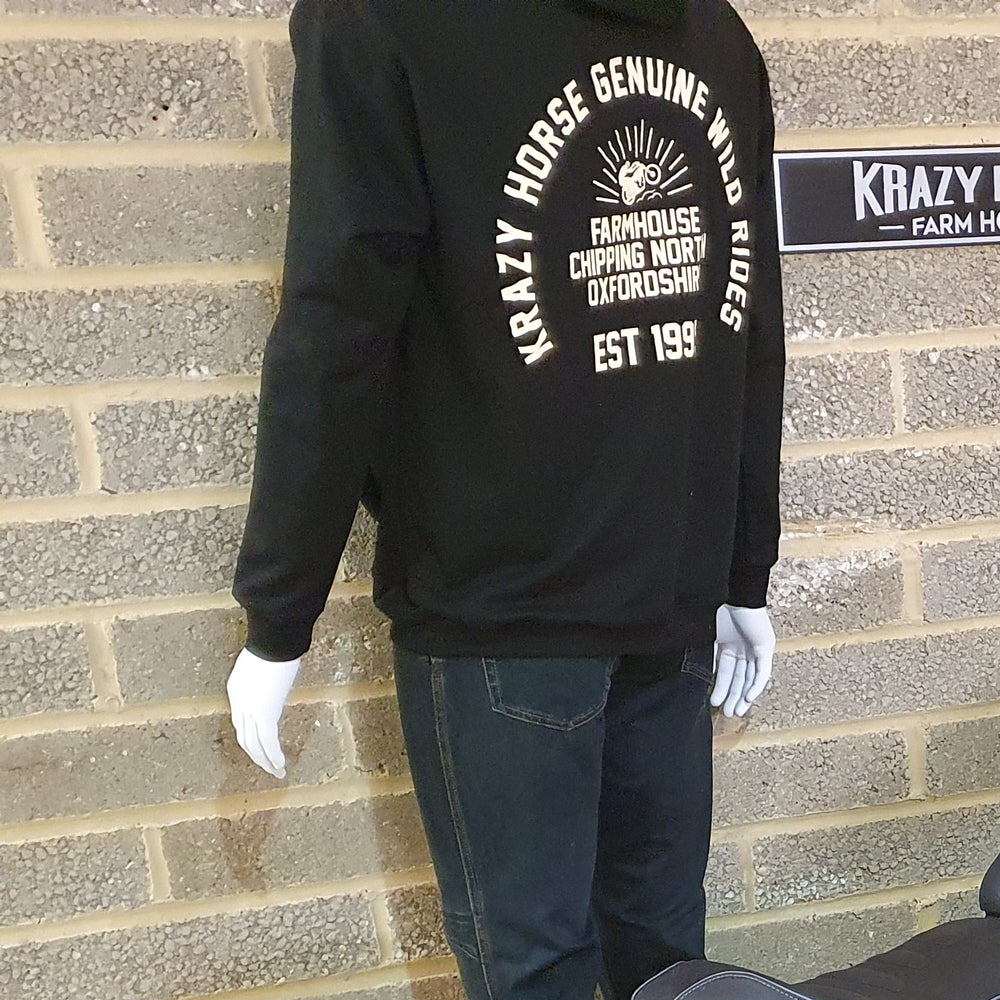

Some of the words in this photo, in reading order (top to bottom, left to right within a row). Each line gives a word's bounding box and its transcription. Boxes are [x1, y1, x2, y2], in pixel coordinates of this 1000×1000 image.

[590, 56, 709, 120] GENUINE
[503, 79, 590, 207] HORSE
[707, 106, 743, 206] WILD
[852, 160, 983, 221] KRAZY
[590, 206, 701, 246] FARMHOUSE
[912, 213, 972, 236] FARM
[569, 242, 645, 280] CHIPPING
[650, 233, 707, 267] NORT
[587, 266, 700, 307] OXFORDSHIR
[720, 219, 750, 332] RIDES
[496, 218, 554, 365] KRAZY
[593, 327, 639, 373] EST
[650, 320, 697, 362] 199
